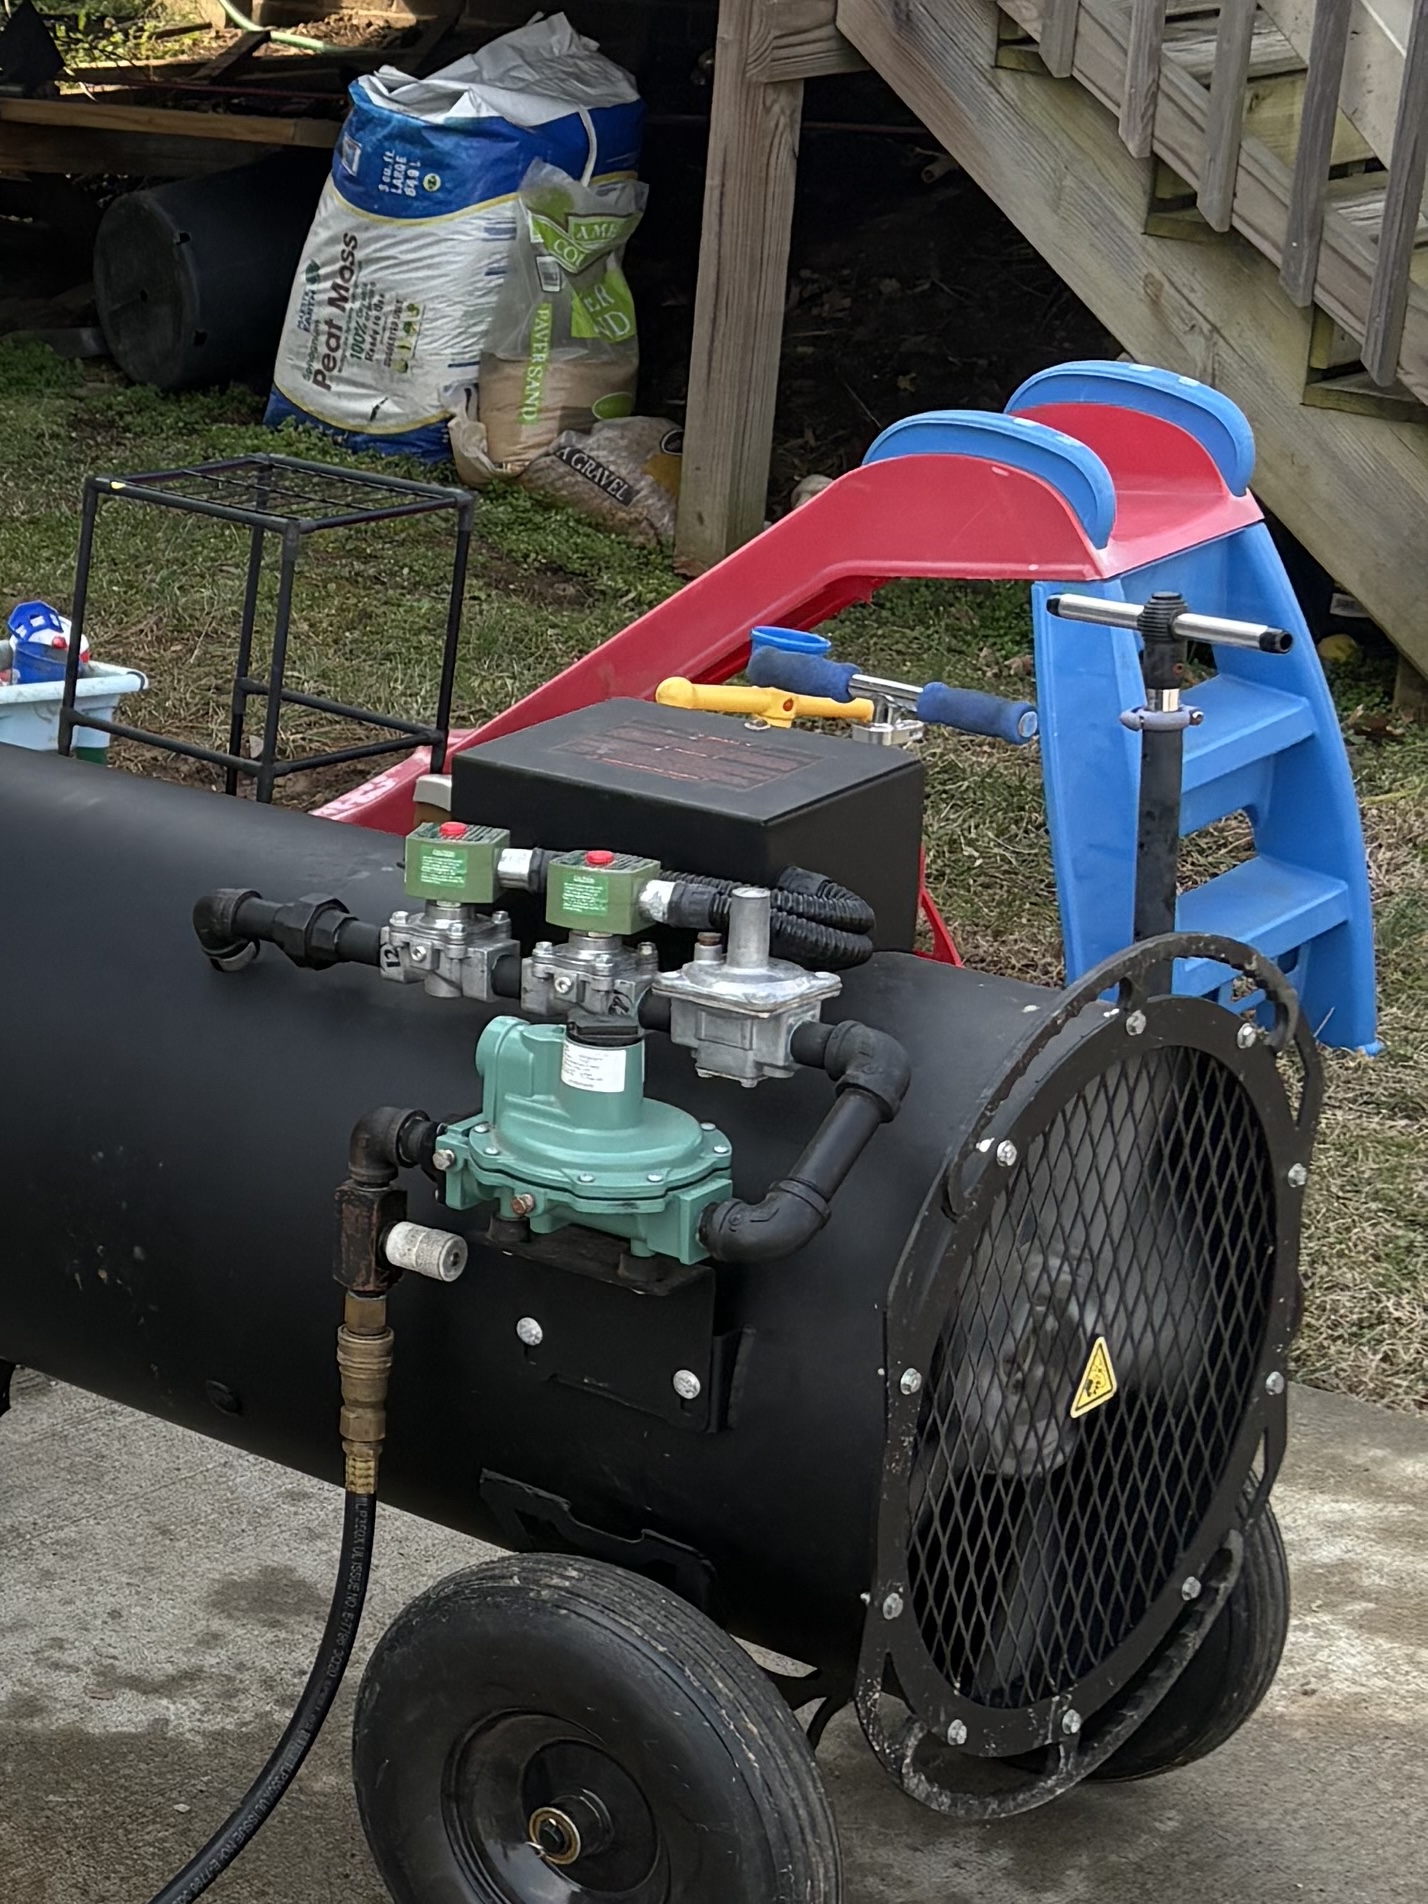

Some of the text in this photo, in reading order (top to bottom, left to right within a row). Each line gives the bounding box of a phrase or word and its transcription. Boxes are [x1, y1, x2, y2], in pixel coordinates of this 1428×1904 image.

[393, 155, 407, 193] LARGE
[312, 317, 341, 391] Peat
[327, 233, 359, 312] Moss
[350, 320, 368, 361] 100%
[522, 309, 549, 419] PAVER SAND
[568, 450, 631, 501] GRAVEL
[348, 1562, 361, 1591] ISSUE
[233, 1812, 262, 1843] ISSUE
